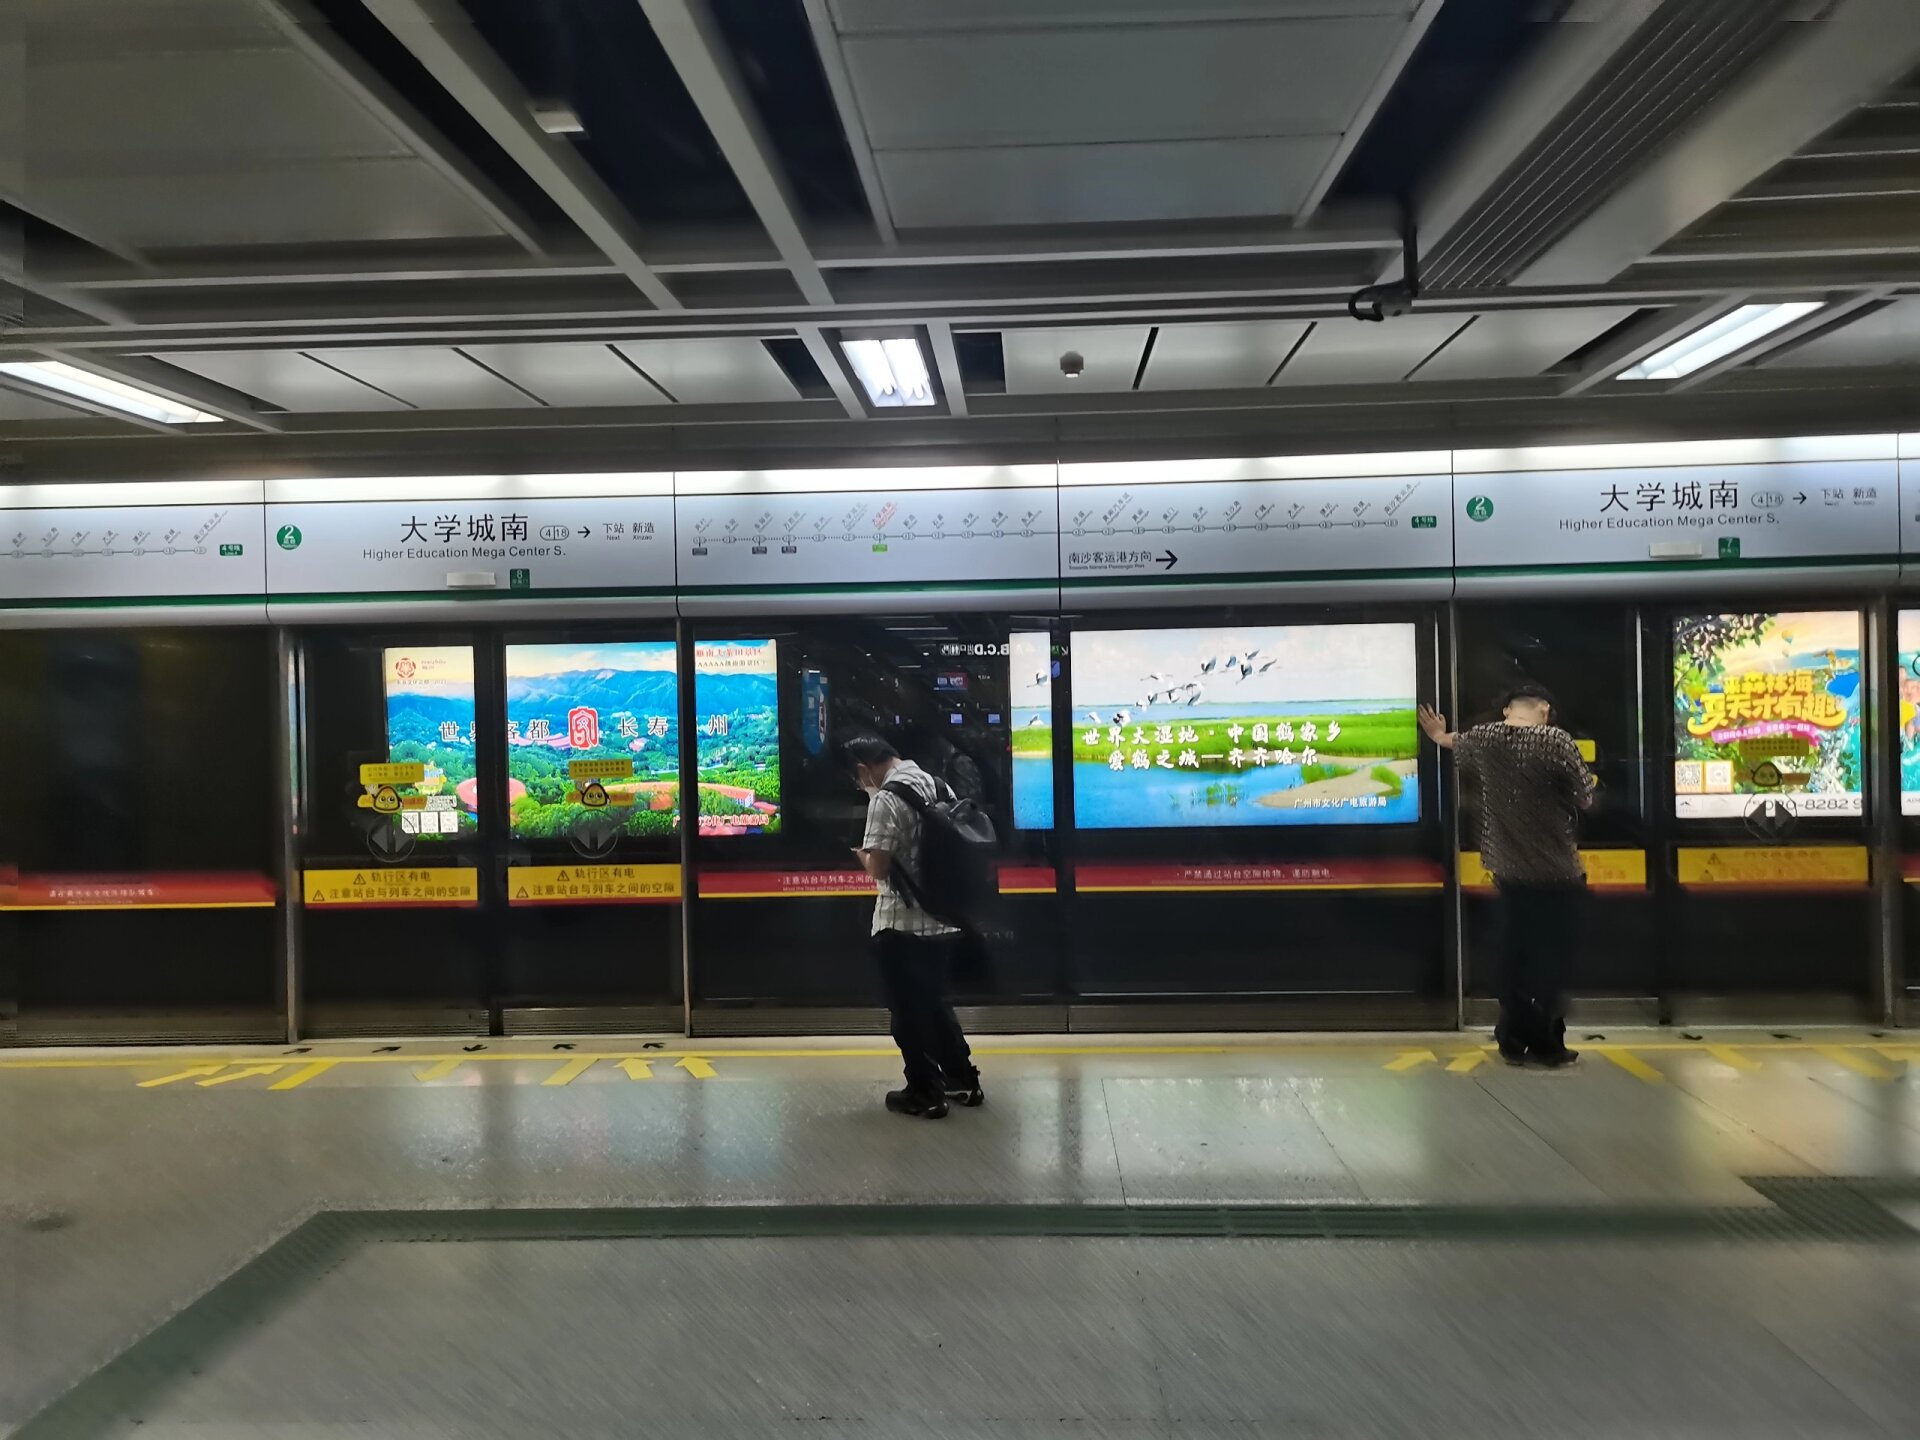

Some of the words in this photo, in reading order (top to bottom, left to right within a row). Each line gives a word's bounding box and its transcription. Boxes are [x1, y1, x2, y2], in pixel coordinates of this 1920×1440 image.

[1600, 480, 1738, 512] 大学城南
[1821, 488, 1844, 500] 下站
[1474, 496, 1485, 509] 2
[401, 513, 528, 543] 大学城南
[602, 522, 624, 534] 下站
[632, 521, 655, 534] 新造
[1559, 518, 1602, 532] Higher
[1607, 517, 1673, 529] Education
[1677, 515, 1713, 529] Mega
[1718, 513, 1762, 525] Center
[284, 525, 294, 538] 2
[555, 528, 567, 538] 18
[363, 548, 403, 561] Higher
[407, 548, 468, 559] Education
[472, 547, 505, 559] Mega
[509, 545, 550, 557] Center
[554, 545, 566, 557] S.
[1068, 550, 1152, 564] 南沙客运港方向
[1688, 693, 1847, 734] 夏天才有趣
[371, 871, 432, 882] 轨行区有电
[575, 867, 635, 879] 轨行区有电
[330, 887, 471, 898] 注意站台与列车之间的空隙
[533, 883, 674, 896] 注意站台与列车之间的空隙
